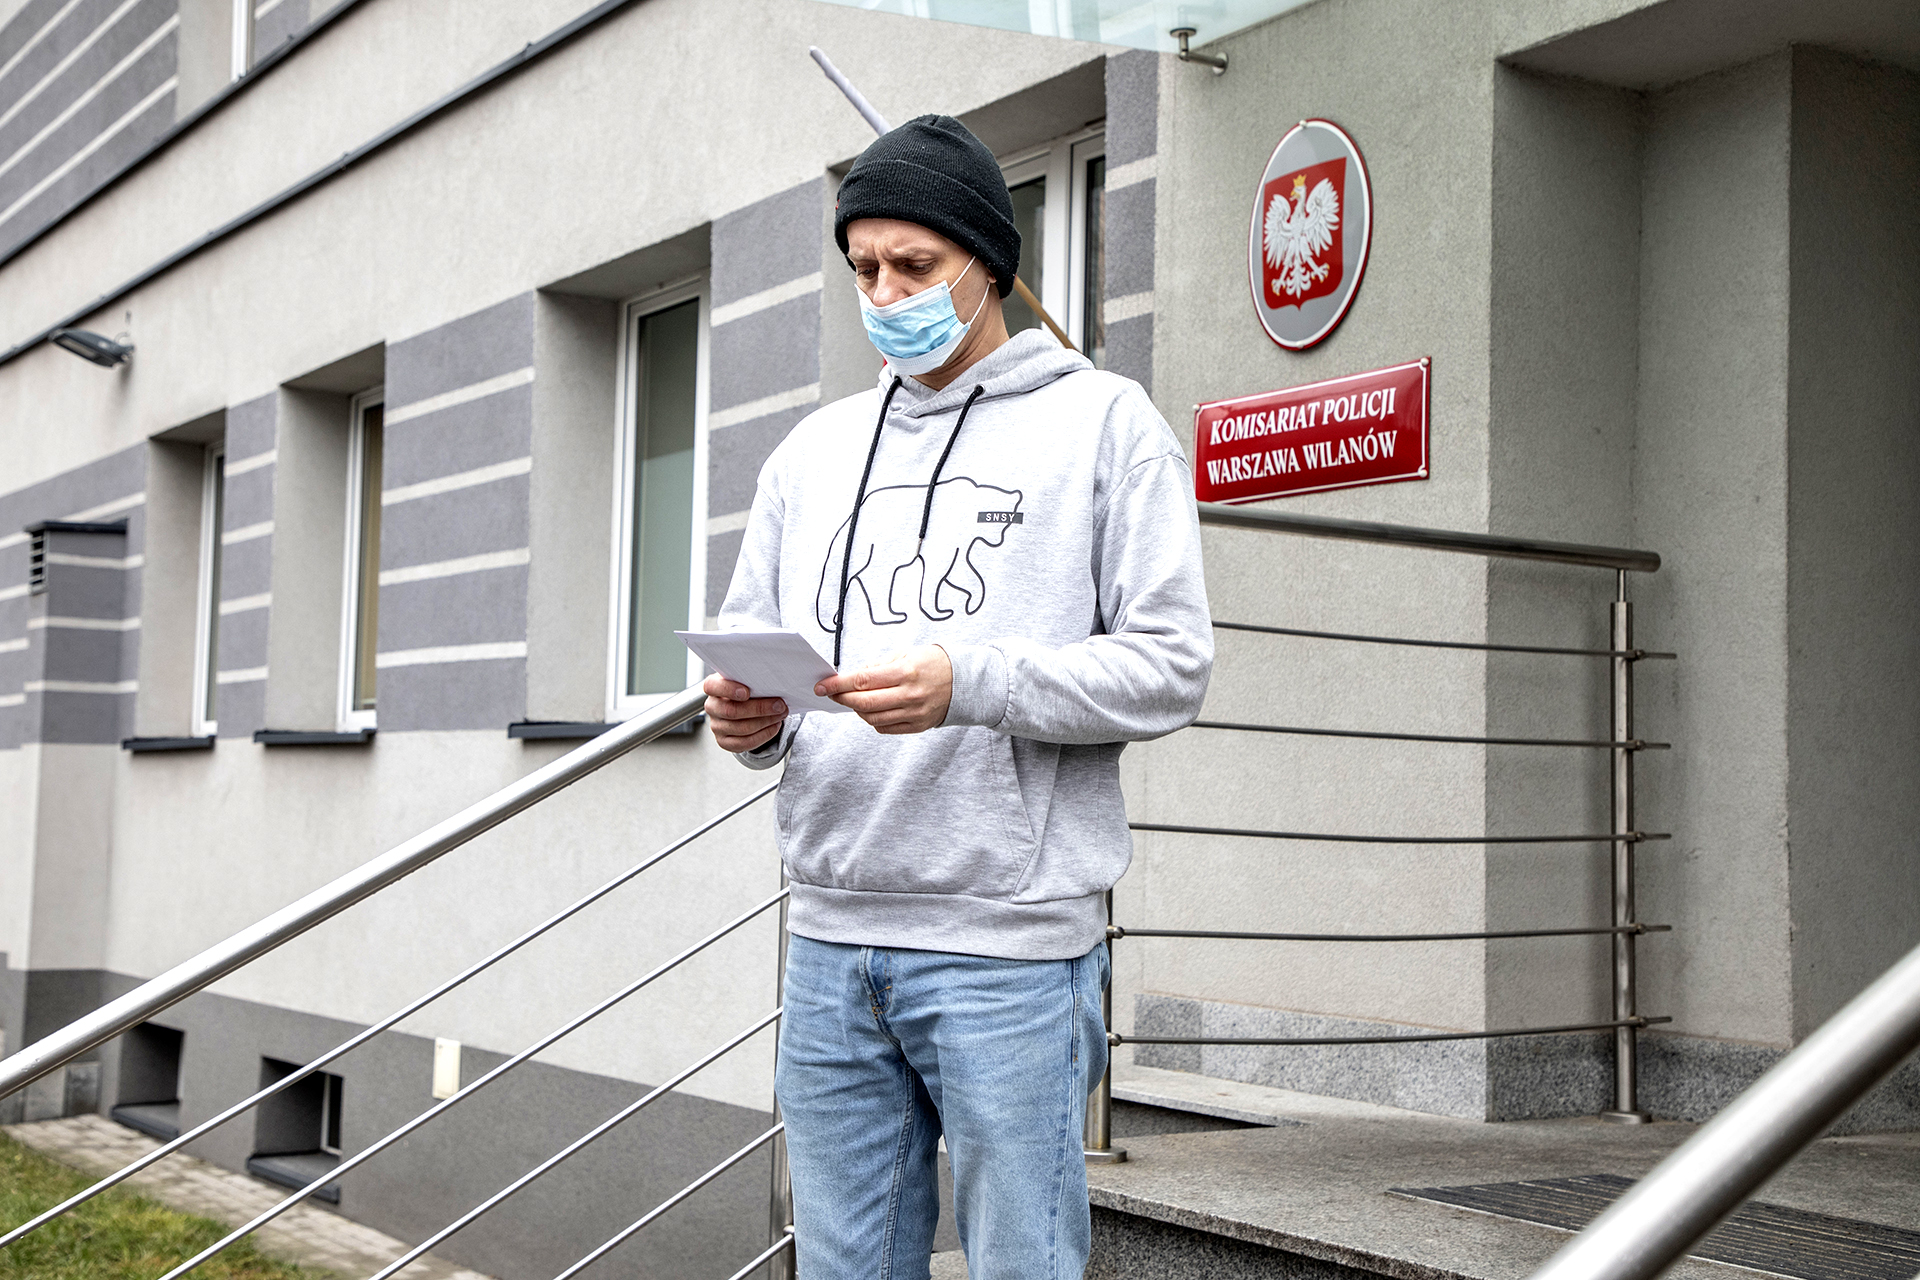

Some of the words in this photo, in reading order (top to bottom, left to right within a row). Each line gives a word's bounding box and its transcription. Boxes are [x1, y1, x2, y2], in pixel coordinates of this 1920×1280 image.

[1209, 400, 1321, 446] KOMISARIAT
[1322, 387, 1397, 425] POLICJI
[1206, 446, 1301, 486] WARSZAWA
[1302, 427, 1398, 471] WILANÓW
[985, 512, 1015, 522] SNSY
